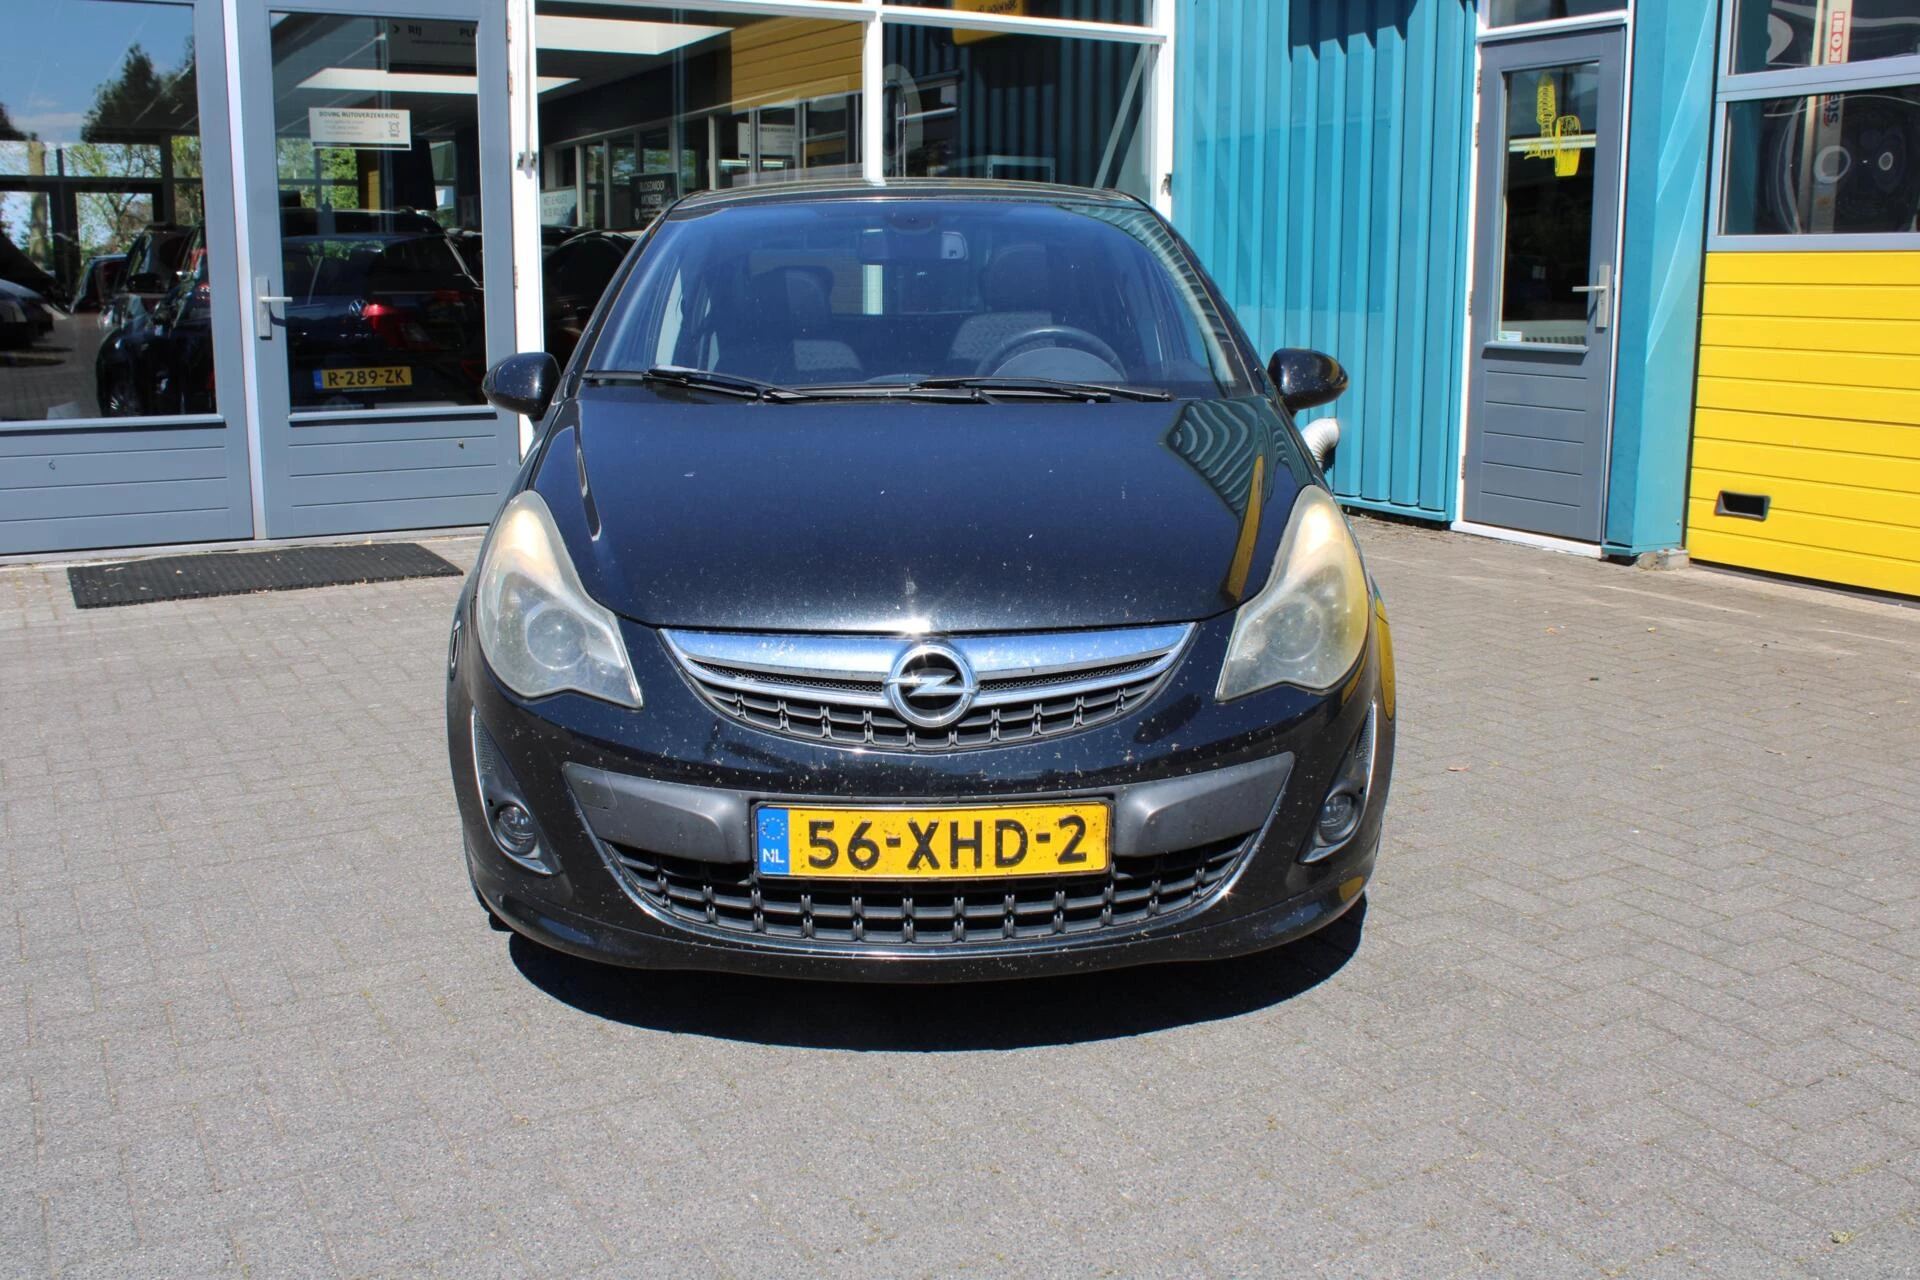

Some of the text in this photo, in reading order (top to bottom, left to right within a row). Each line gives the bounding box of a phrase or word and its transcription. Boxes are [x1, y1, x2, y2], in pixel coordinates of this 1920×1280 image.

[1830, 12, 1845, 62] KONI
[327, 368, 405, 386] R-289-ZK
[762, 848, 785, 864] NL
[808, 815, 1087, 870] 56-XHD-2
